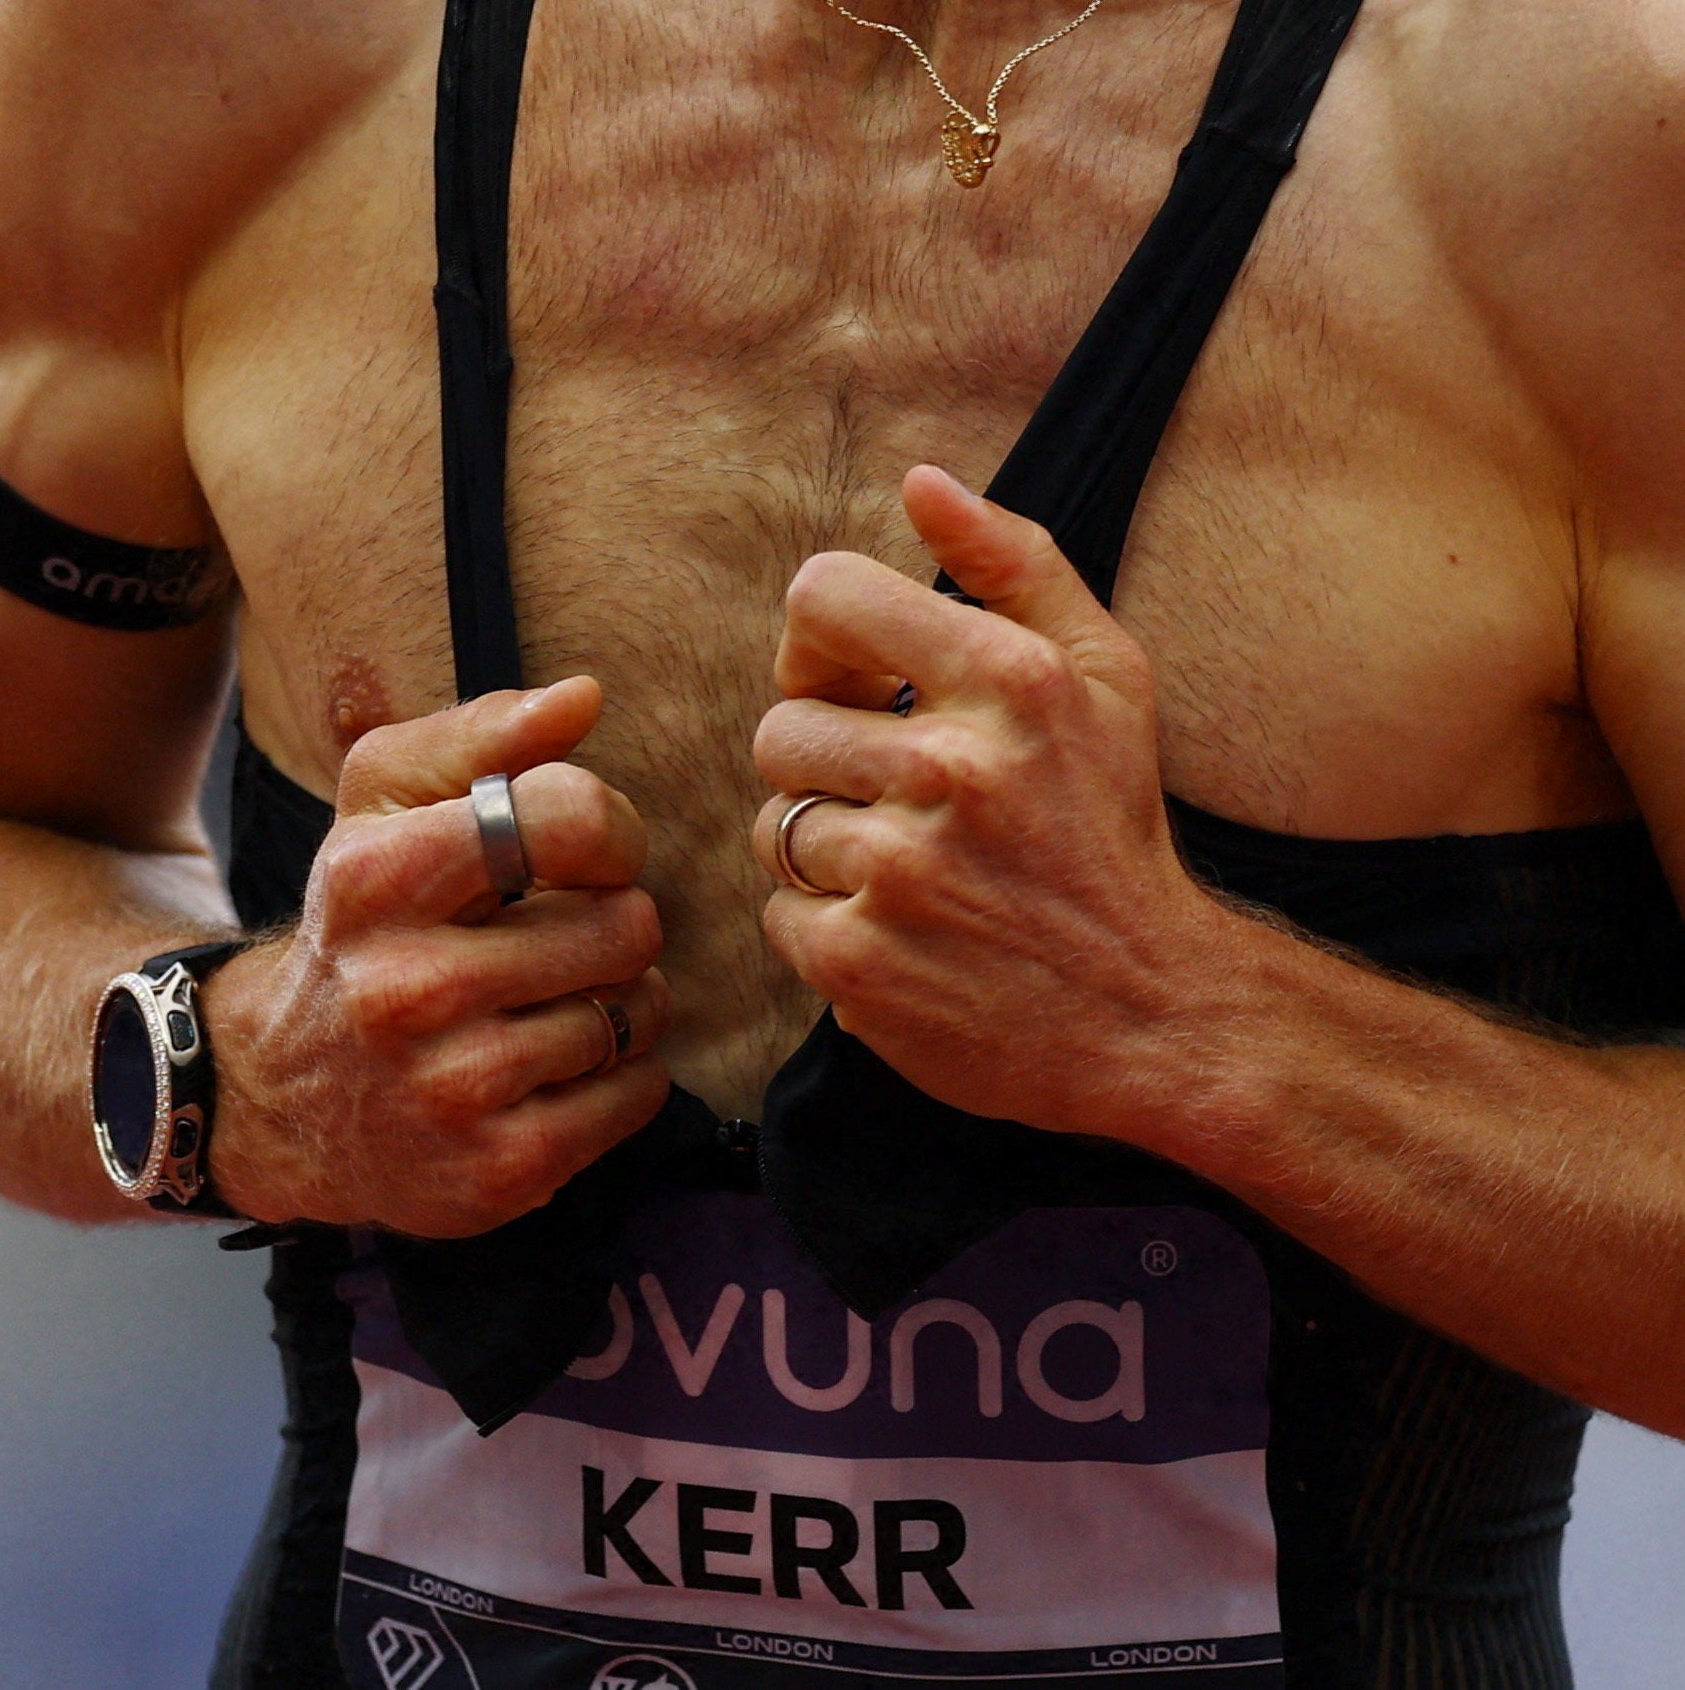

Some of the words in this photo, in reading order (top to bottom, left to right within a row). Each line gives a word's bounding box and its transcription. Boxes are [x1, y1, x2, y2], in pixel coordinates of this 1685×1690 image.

[582, 1464, 975, 1610] KERR
[409, 1573, 494, 1614] LONDON
[716, 1631, 834, 1661] LONDON
[1090, 1643, 1217, 1667] LONDON
